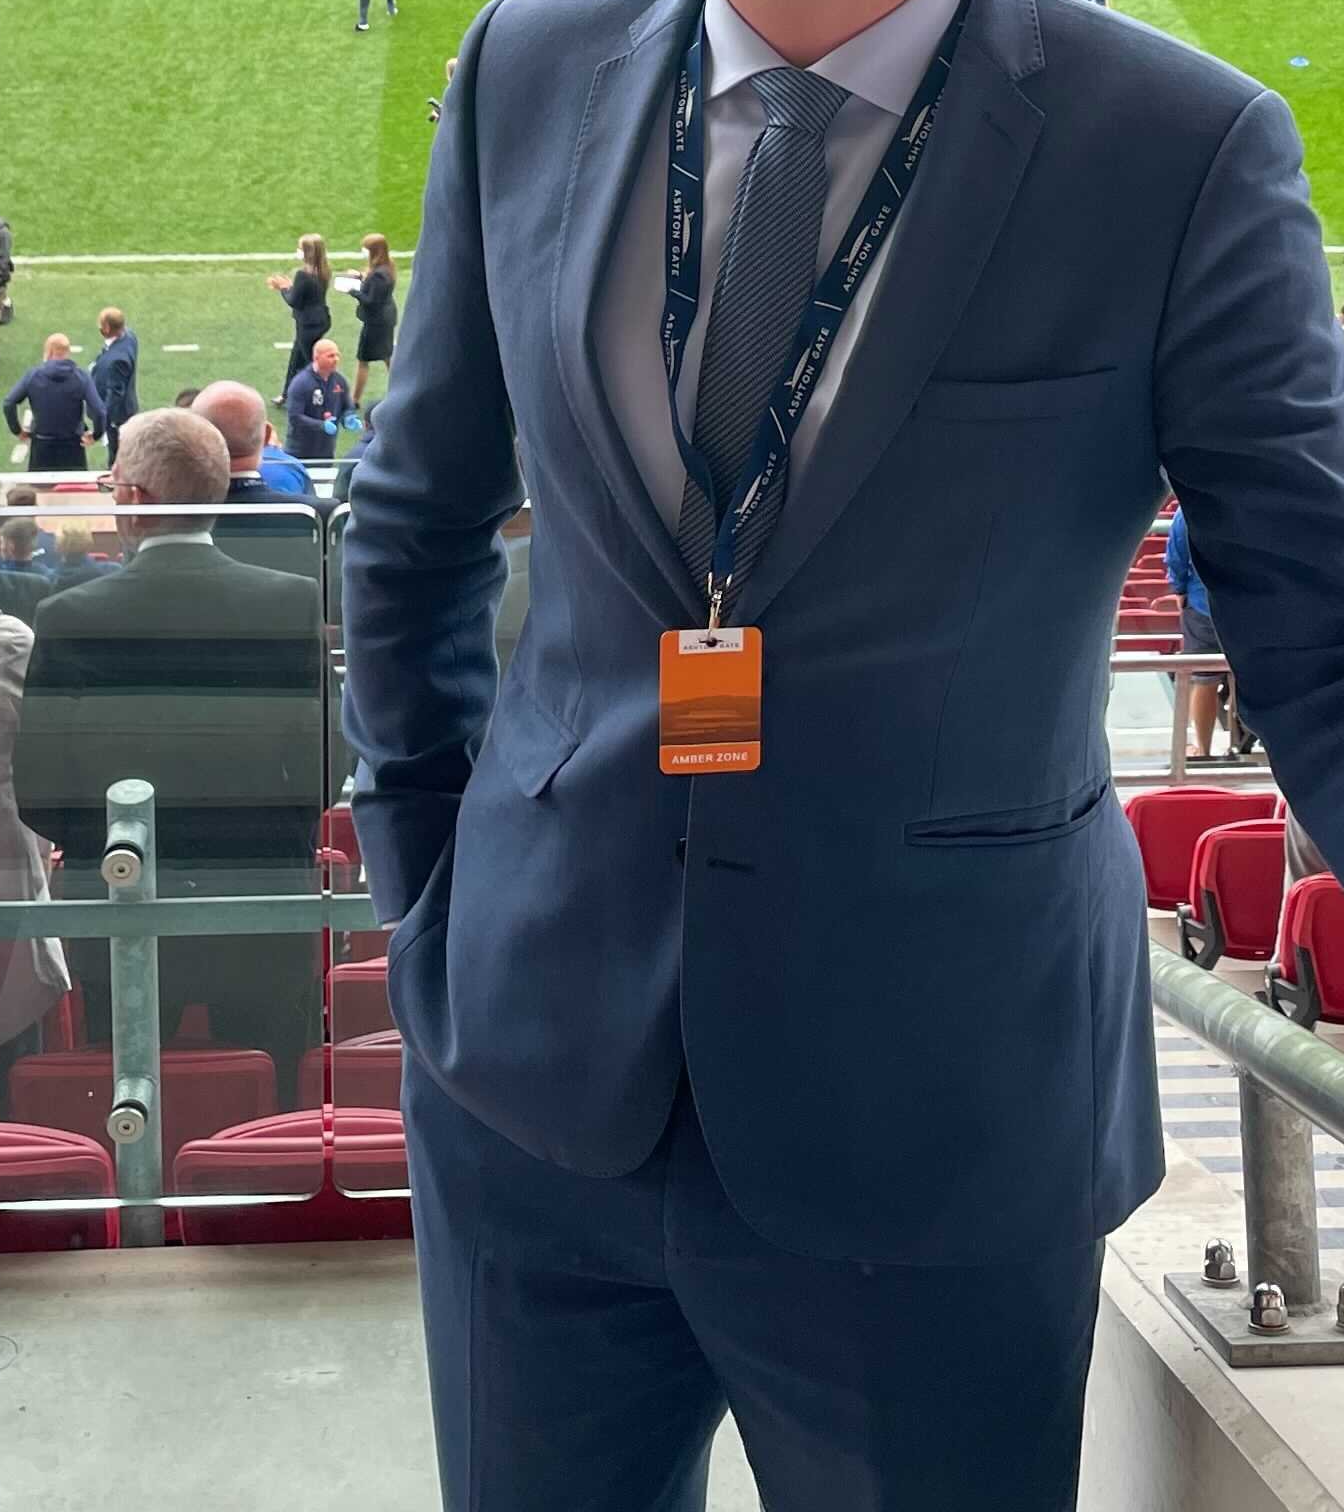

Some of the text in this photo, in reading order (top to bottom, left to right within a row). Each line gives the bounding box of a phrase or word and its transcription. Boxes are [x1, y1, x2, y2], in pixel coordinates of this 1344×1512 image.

[674, 120, 685, 151] GATE
[903, 121, 933, 171] ASHTON
[671, 188, 683, 277] ASHTON GATE
[842, 205, 892, 292] ASHTON GATE
[788, 326, 831, 418] ASHTON GATE
[761, 451, 777, 486] GATE
[672, 751, 748, 765] AMBER ZONE
